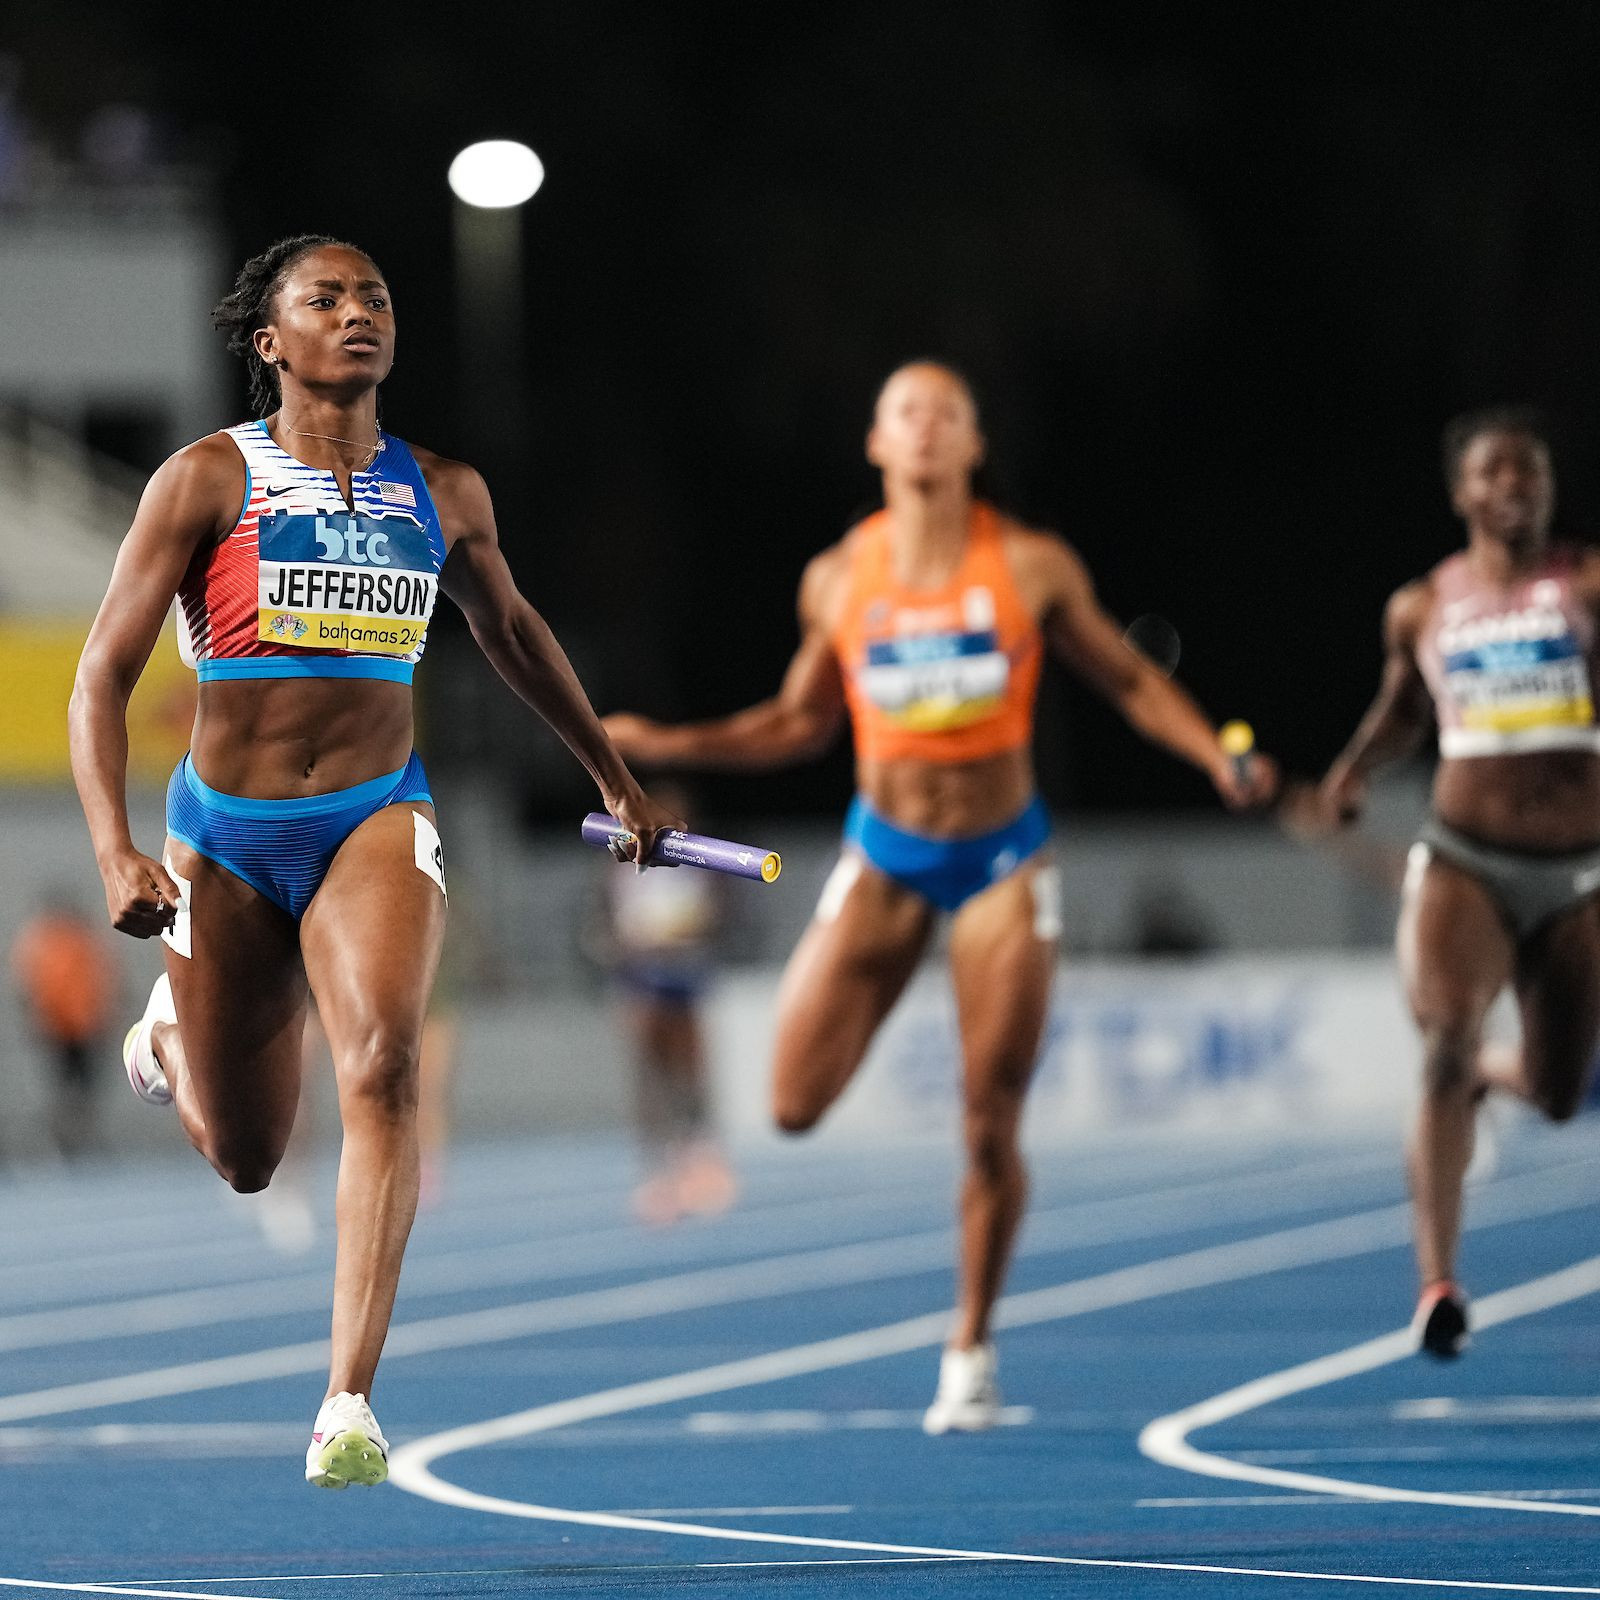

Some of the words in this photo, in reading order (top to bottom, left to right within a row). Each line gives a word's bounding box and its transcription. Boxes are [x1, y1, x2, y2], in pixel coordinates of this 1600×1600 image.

[315, 516, 391, 565] btc
[268, 568, 429, 617] JEFFERSON
[664, 848, 705, 865] bahamas24
